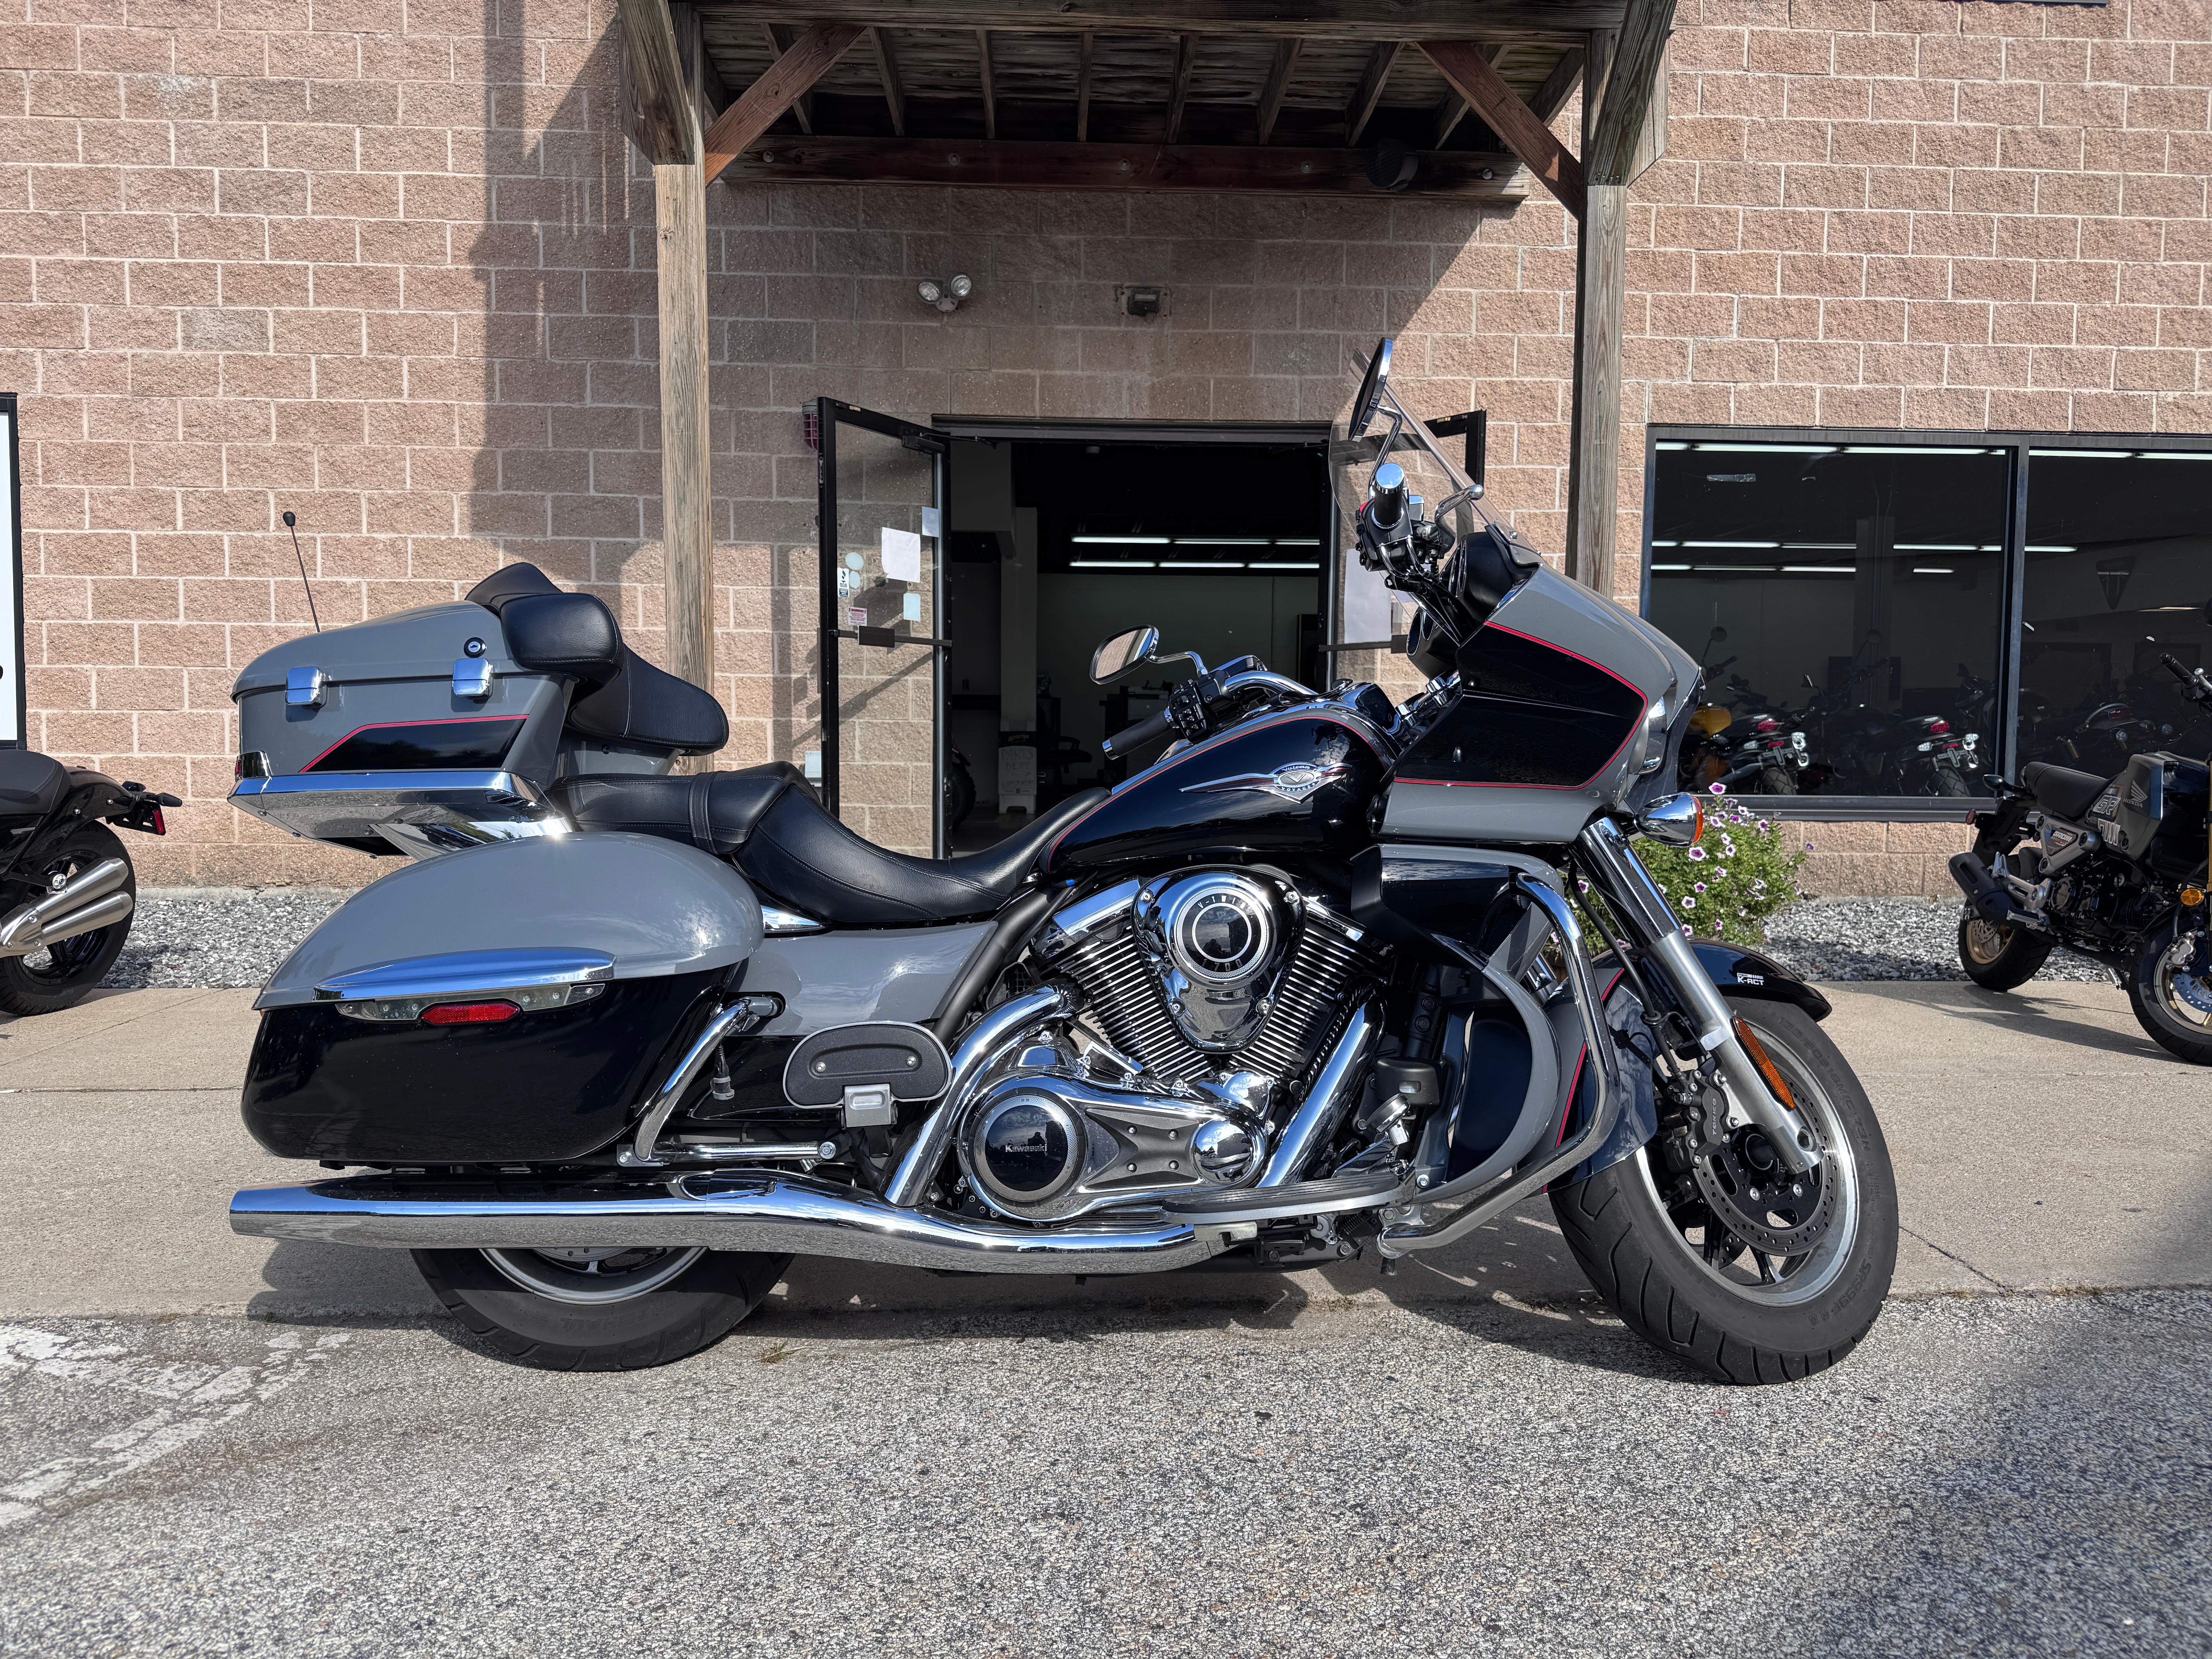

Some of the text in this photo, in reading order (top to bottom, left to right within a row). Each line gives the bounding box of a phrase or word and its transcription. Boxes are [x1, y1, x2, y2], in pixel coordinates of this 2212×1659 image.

[1002, 749, 1034, 762] PARTS
[1281, 783, 1316, 792] VOYAGER
[2123, 798, 2143, 807] HONDA
[2052, 831, 2073, 842] GROM
[1197, 895, 1247, 909] V-TWIN
[1202, 958, 1243, 972] 1700
[1737, 976, 1764, 986] K-ACT
[1005, 1144, 1047, 1152] Kawasaki
